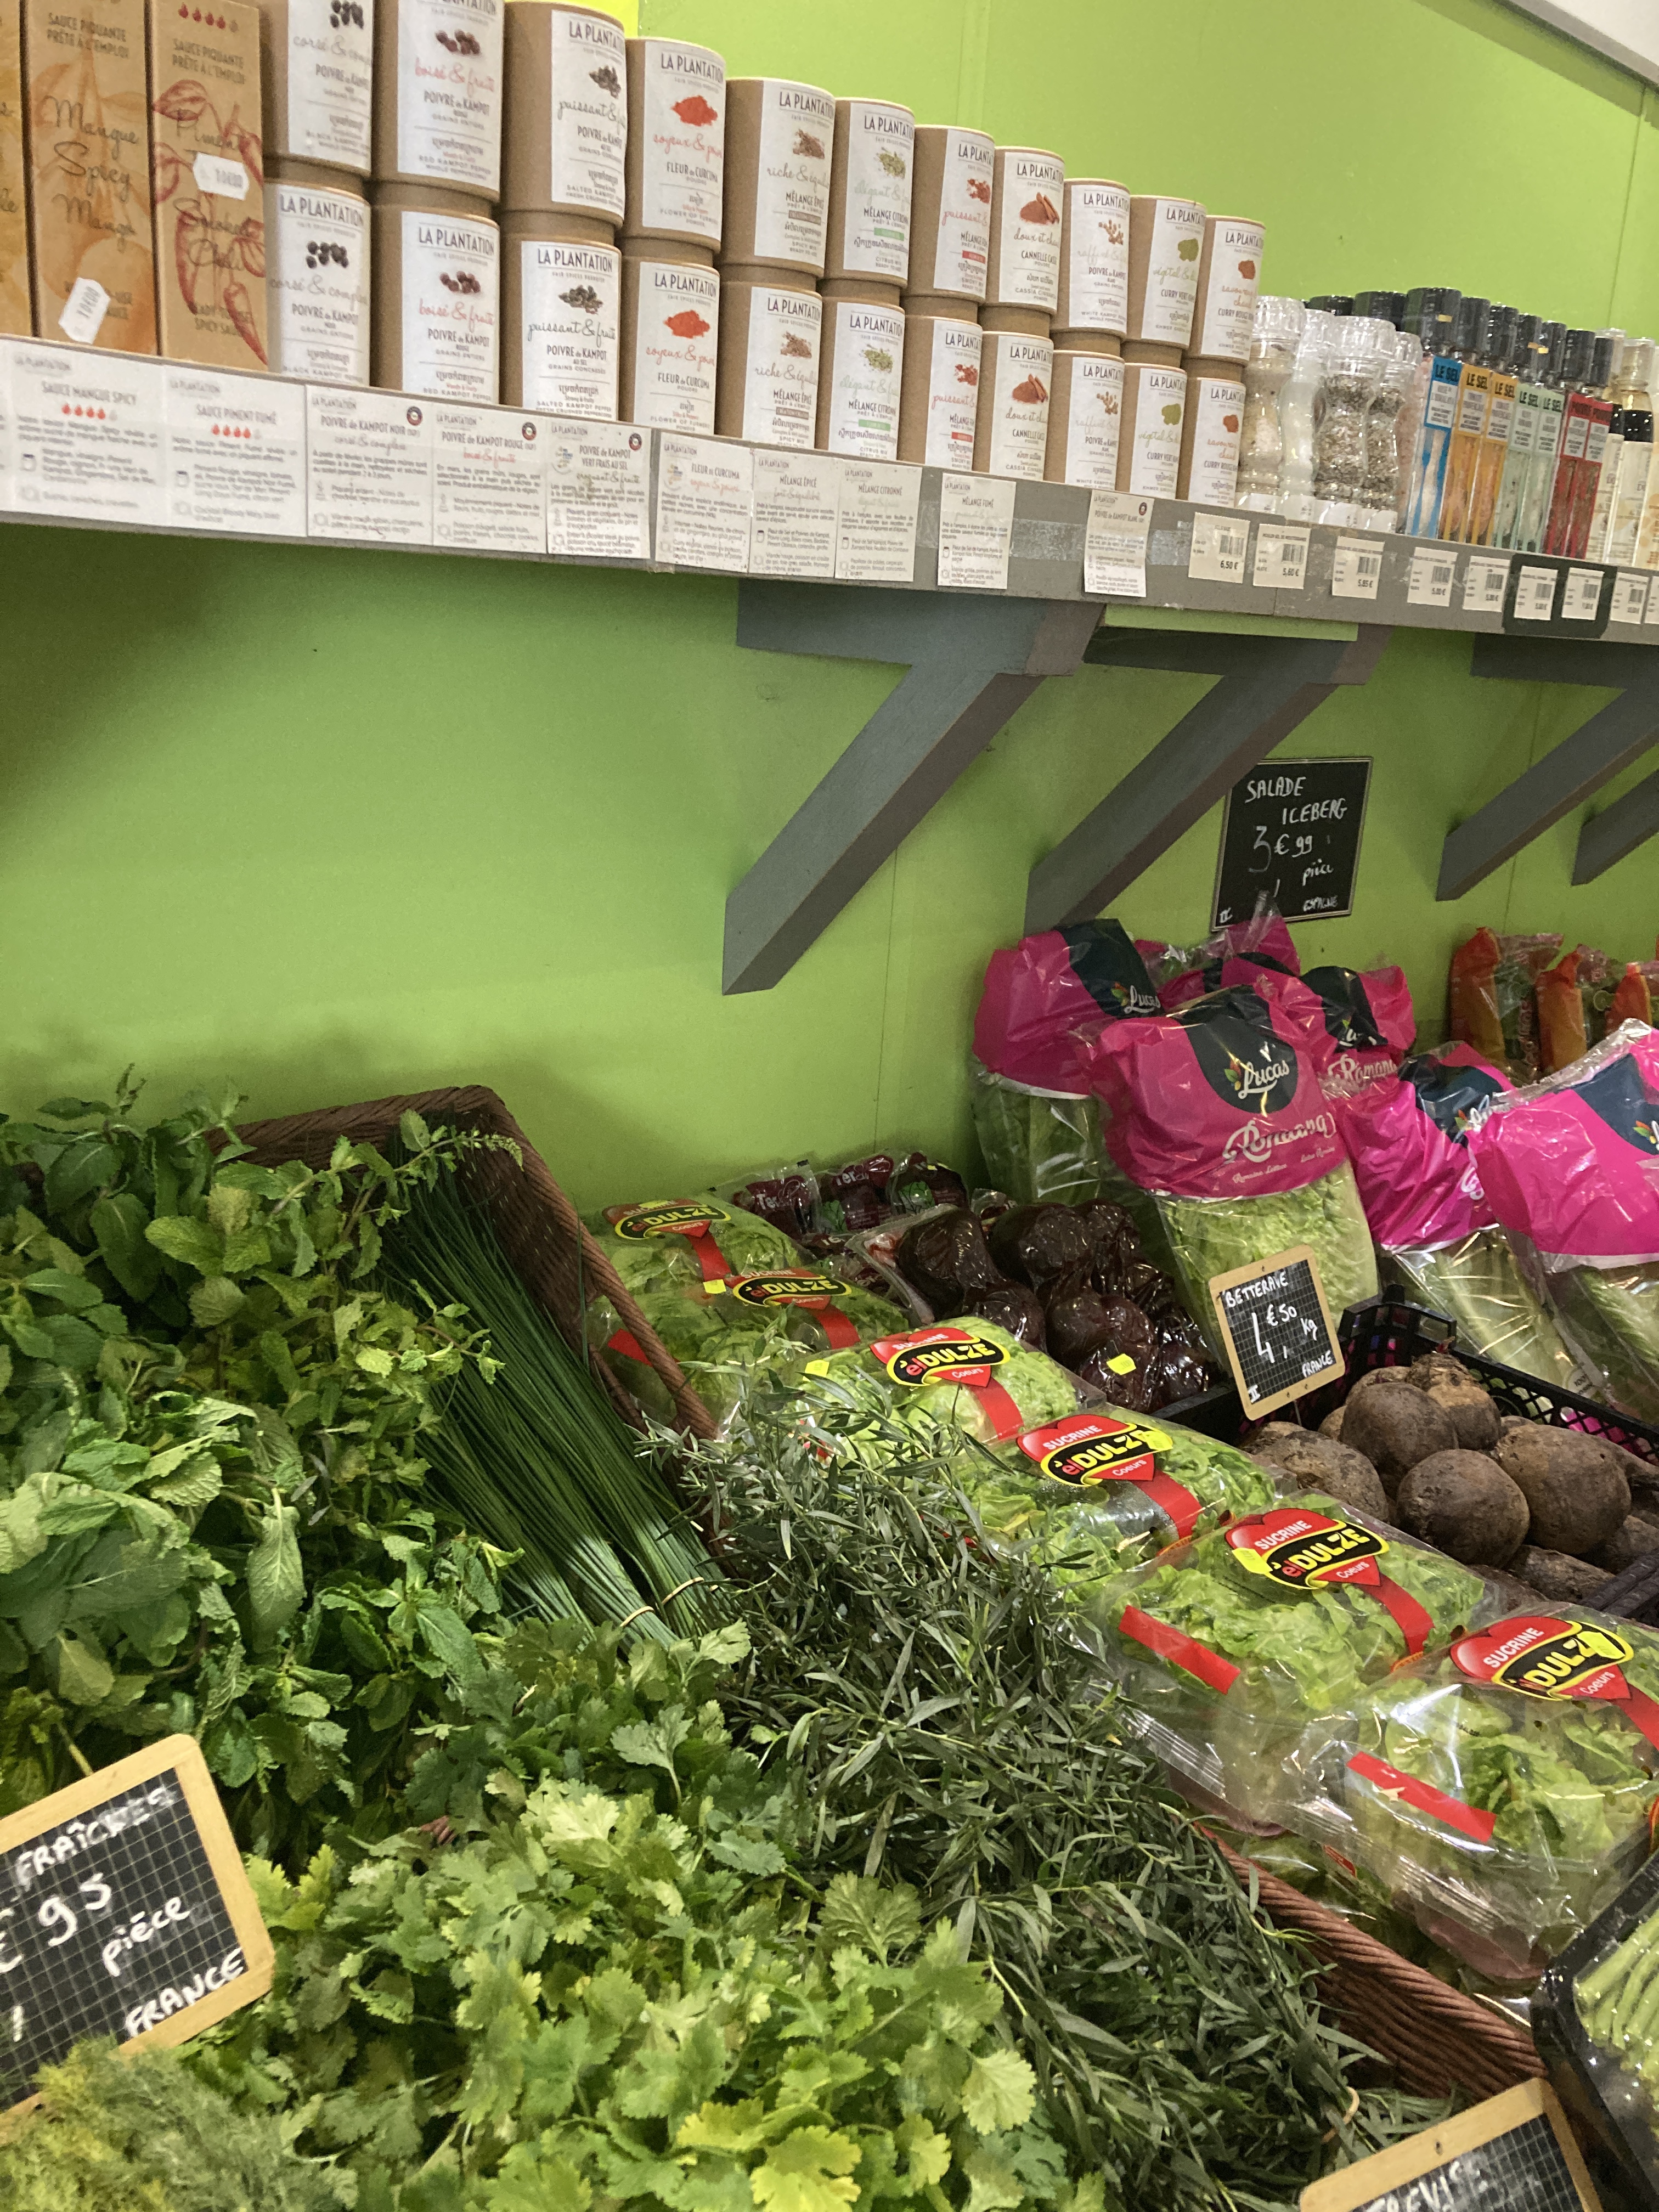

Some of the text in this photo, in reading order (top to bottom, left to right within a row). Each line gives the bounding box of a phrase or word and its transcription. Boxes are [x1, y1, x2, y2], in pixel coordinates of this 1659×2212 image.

[569, 20, 582, 38] LA
[661, 53, 674, 70] LA
[779, 91, 791, 107] LA
[42, 95, 139, 161] Mangue
[864, 115, 876, 131] LA
[958, 143, 968, 158] LA
[54, 140, 130, 203] Spicy
[667, 161, 689, 175] FLEUR
[1017, 162, 1026, 176] LA
[1084, 193, 1094, 205] LA
[280, 194, 364, 227] LA PLANTATION
[1166, 207, 1176, 221] LA
[419, 227, 494, 255] LA PLANTATION
[1225, 231, 1235, 244] LA
[538, 248, 612, 273] LA PLANTATION
[1088, 266, 1108, 275] POIVRE
[654, 272, 716, 298] LA PLANTATION
[292, 303, 324, 319] POIVRE
[768, 297, 778, 312] LA
[850, 314, 861, 329] LA
[428, 328, 490, 348] POIVRE KAMPOT
[527, 321, 581, 342] puissant
[946, 332, 955, 346] LA
[547, 345, 607, 361] POIVRE KAMPOT
[1010, 345, 1020, 358] LA
[754, 363, 782, 379] riche
[1084, 365, 1093, 377] LA
[658, 373, 710, 390] FLEUR CURCUMA
[1150, 375, 1159, 387] LA
[773, 388, 800, 403] MÉLANGE
[1211, 388, 1220, 399] LA
[849, 399, 877, 412] MÉLANGE
[1147, 452, 1163, 461] CURRY
[714, 467, 740, 480] CURCUMA
[780, 475, 803, 487] MÉLANGE
[858, 483, 879, 494] MÉLANGE
[1220, 560, 1233, 569] 6,50
[1244, 776, 1307, 804] SALADE
[1282, 798, 1348, 825] ICEBERG
[1238, 1059, 1290, 1100] Lucas
[672, 1221, 704, 1232] Coeurs
[1221, 1270, 1289, 1308] BETTERAVE
[1301, 1349, 1334, 1378] FRANCE
[951, 1367, 984, 1379] Coeurs
[1042, 1424, 1103, 1451] SUCRINE
[1111, 1459, 1147, 1477] Coeurs
[1253, 1519, 1313, 1551] SUCRINE
[1335, 1560, 1370, 1579] Coeurs
[1482, 1627, 1545, 1669] SUCRINE
[1579, 1669, 1616, 1696] Coeurs
[122, 1947, 245, 2038] FRANCE
